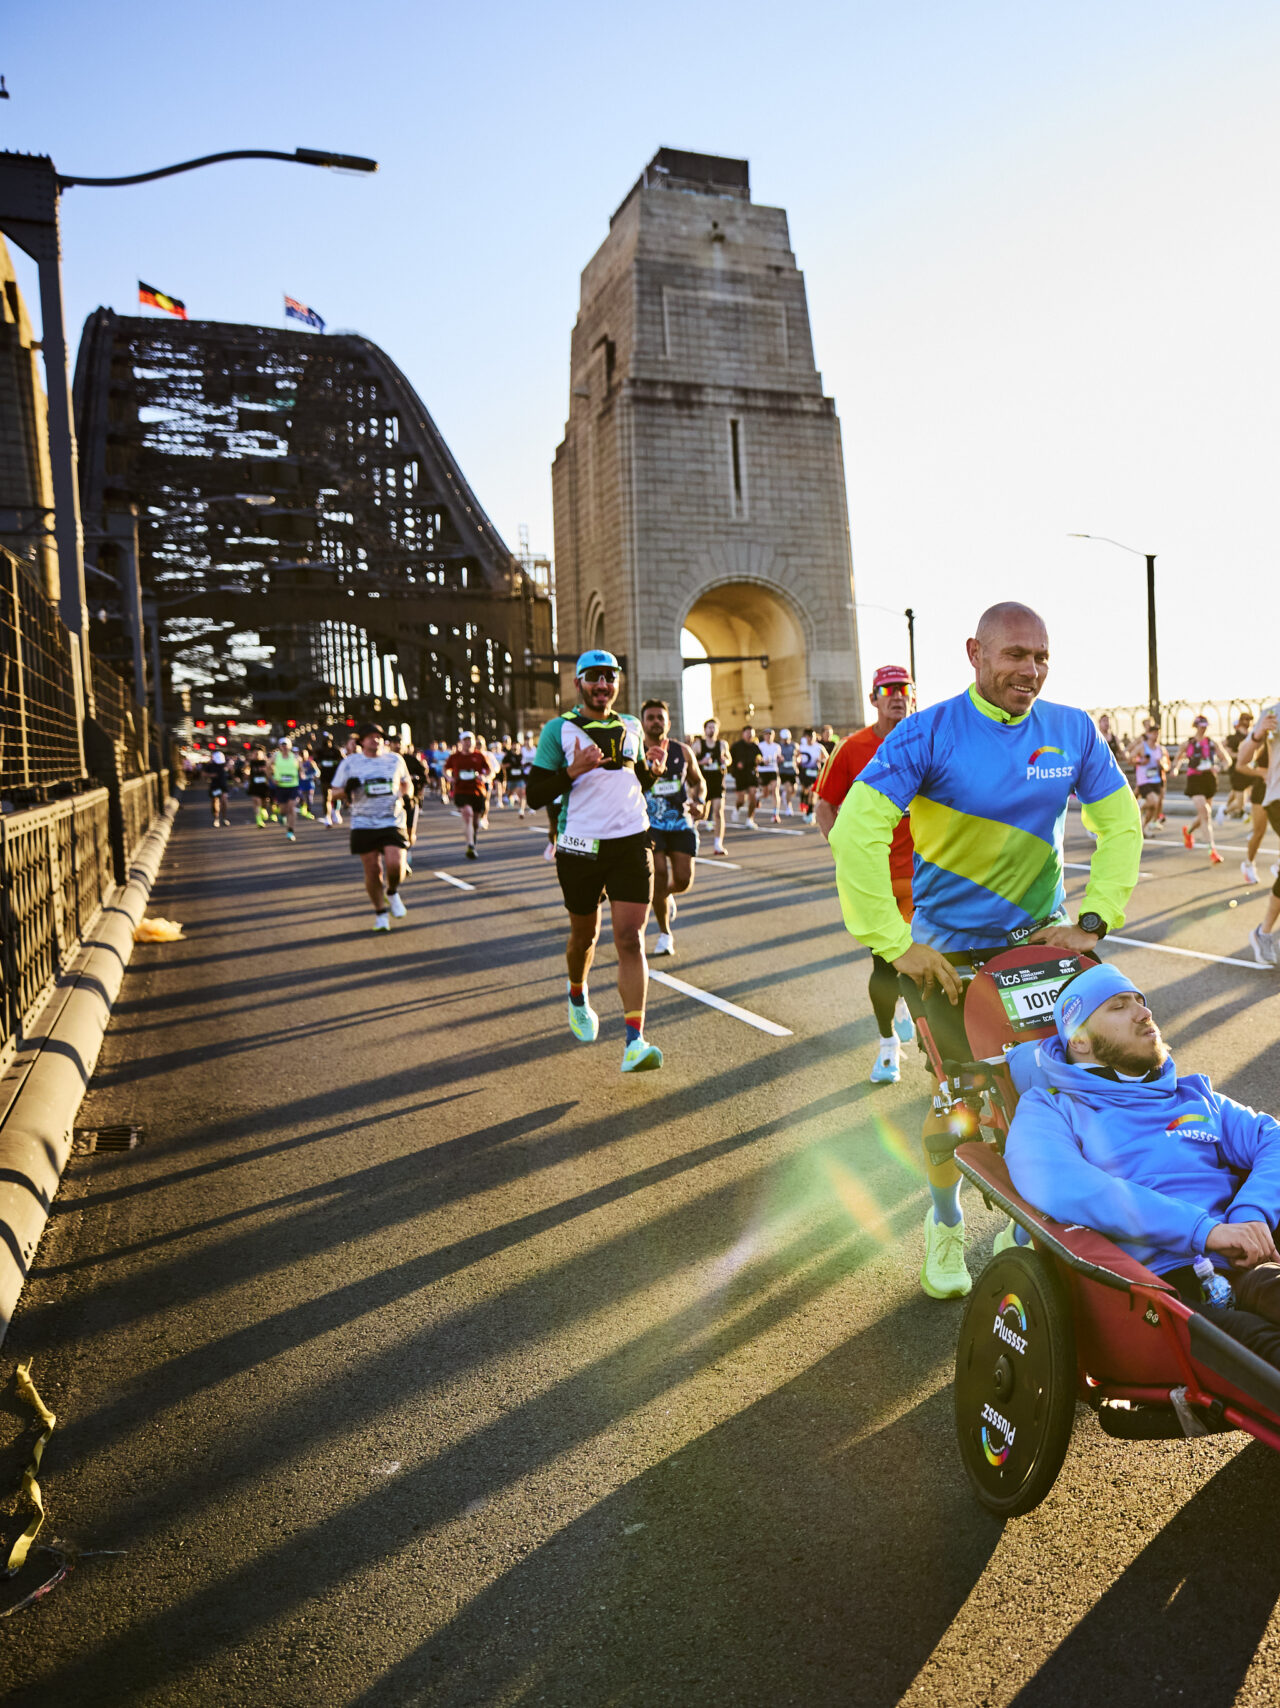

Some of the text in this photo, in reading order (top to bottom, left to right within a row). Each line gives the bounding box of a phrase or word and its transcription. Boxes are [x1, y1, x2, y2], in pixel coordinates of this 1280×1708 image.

[1026, 766, 1073, 780] Plusssz
[1000, 973, 1021, 986] tcs
[993, 1315, 1028, 1355] Plusssz
[981, 1403, 1016, 1446] Plusssz
